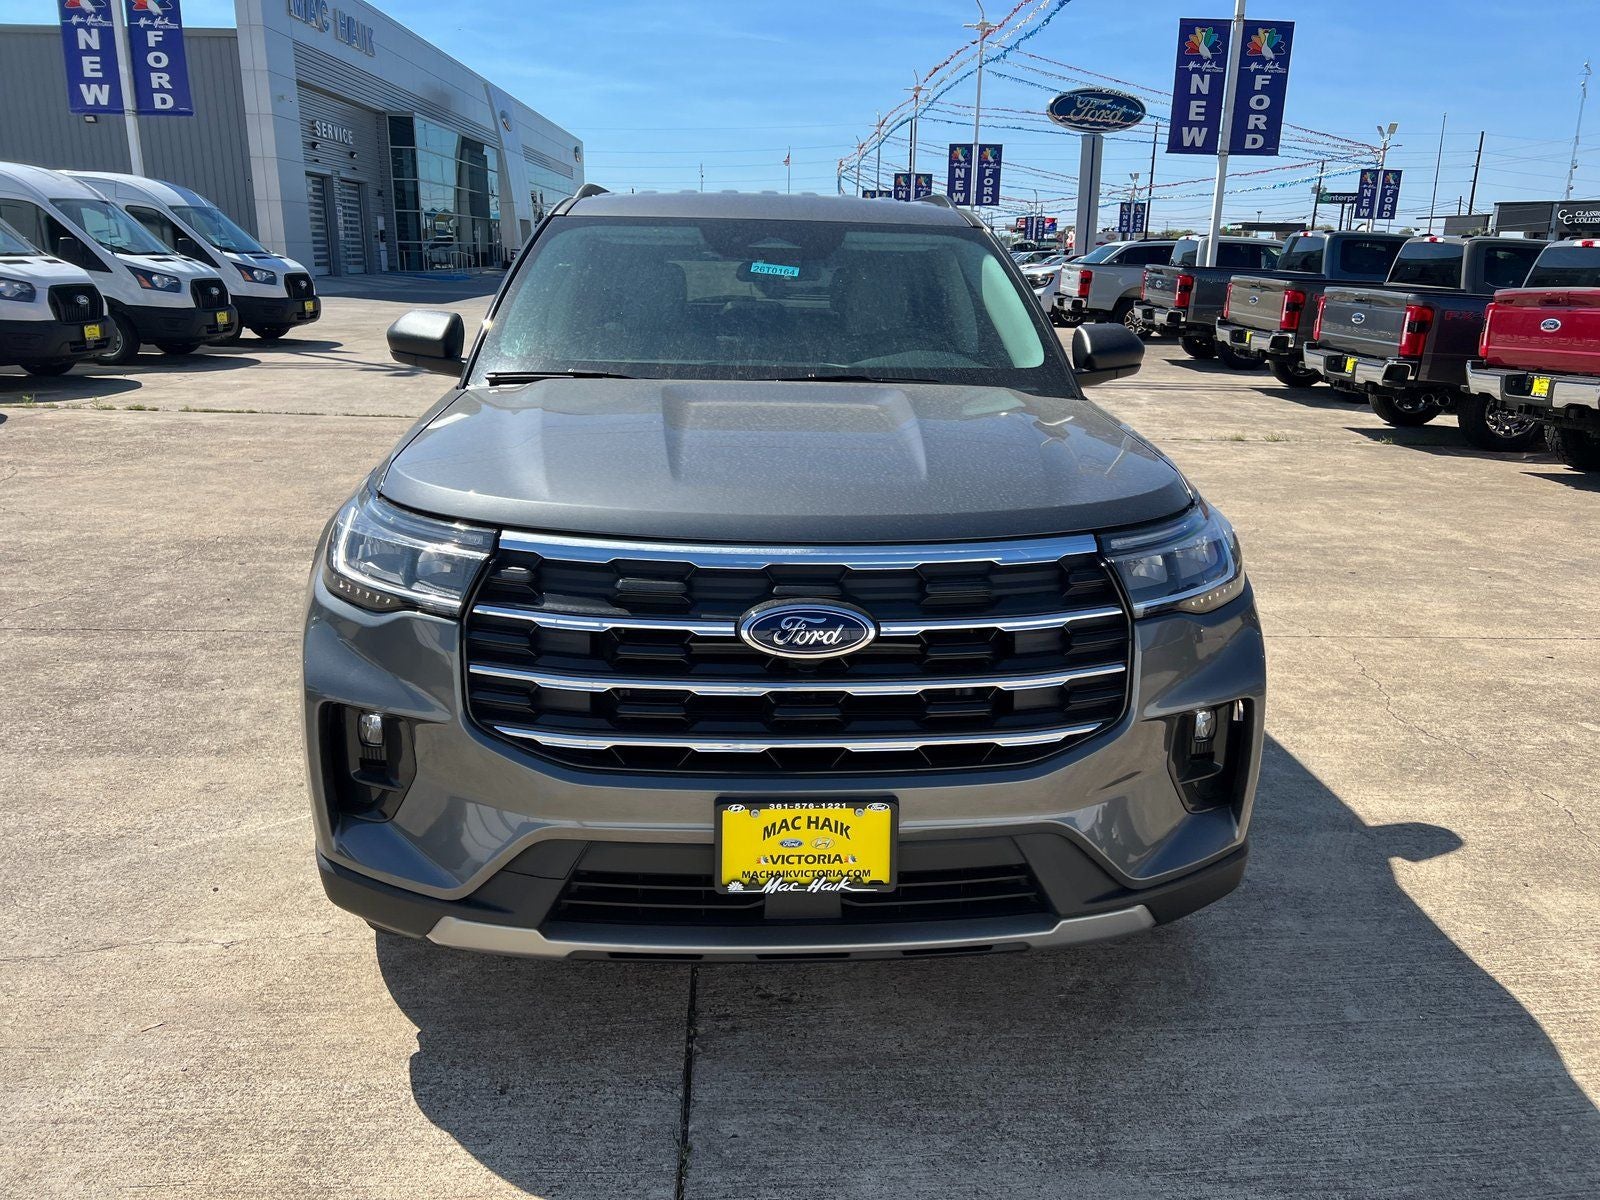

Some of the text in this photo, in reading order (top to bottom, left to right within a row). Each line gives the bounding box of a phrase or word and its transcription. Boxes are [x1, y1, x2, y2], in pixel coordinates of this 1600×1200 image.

[286, 0, 376, 57] MAC HAIK
[77, 28, 109, 105] NEW
[146, 30, 174, 109] FORD
[1070, 95, 1125, 122] Ford
[1182, 73, 1211, 147] NEW
[1244, 74, 1272, 149] FORD
[314, 120, 354, 145] SERVICE
[952, 168, 966, 202] NEW
[982, 168, 995, 204] FORD
[1322, 195, 1358, 203] enterpr
[1360, 189, 1371, 217] NEW
[1382, 189, 1394, 218] FORD
[1121, 213, 1129, 232] NEW
[753, 265, 796, 276] 26T0164
[1559, 337, 1600, 347] DUT
[773, 616, 844, 645] Ford
[763, 816, 851, 841] MAC HAIK
[769, 854, 844, 865] VICTORIA
[742, 869, 872, 879] MACHAIKVICTORIA.COM
[763, 877, 853, 893] Mac Haik
